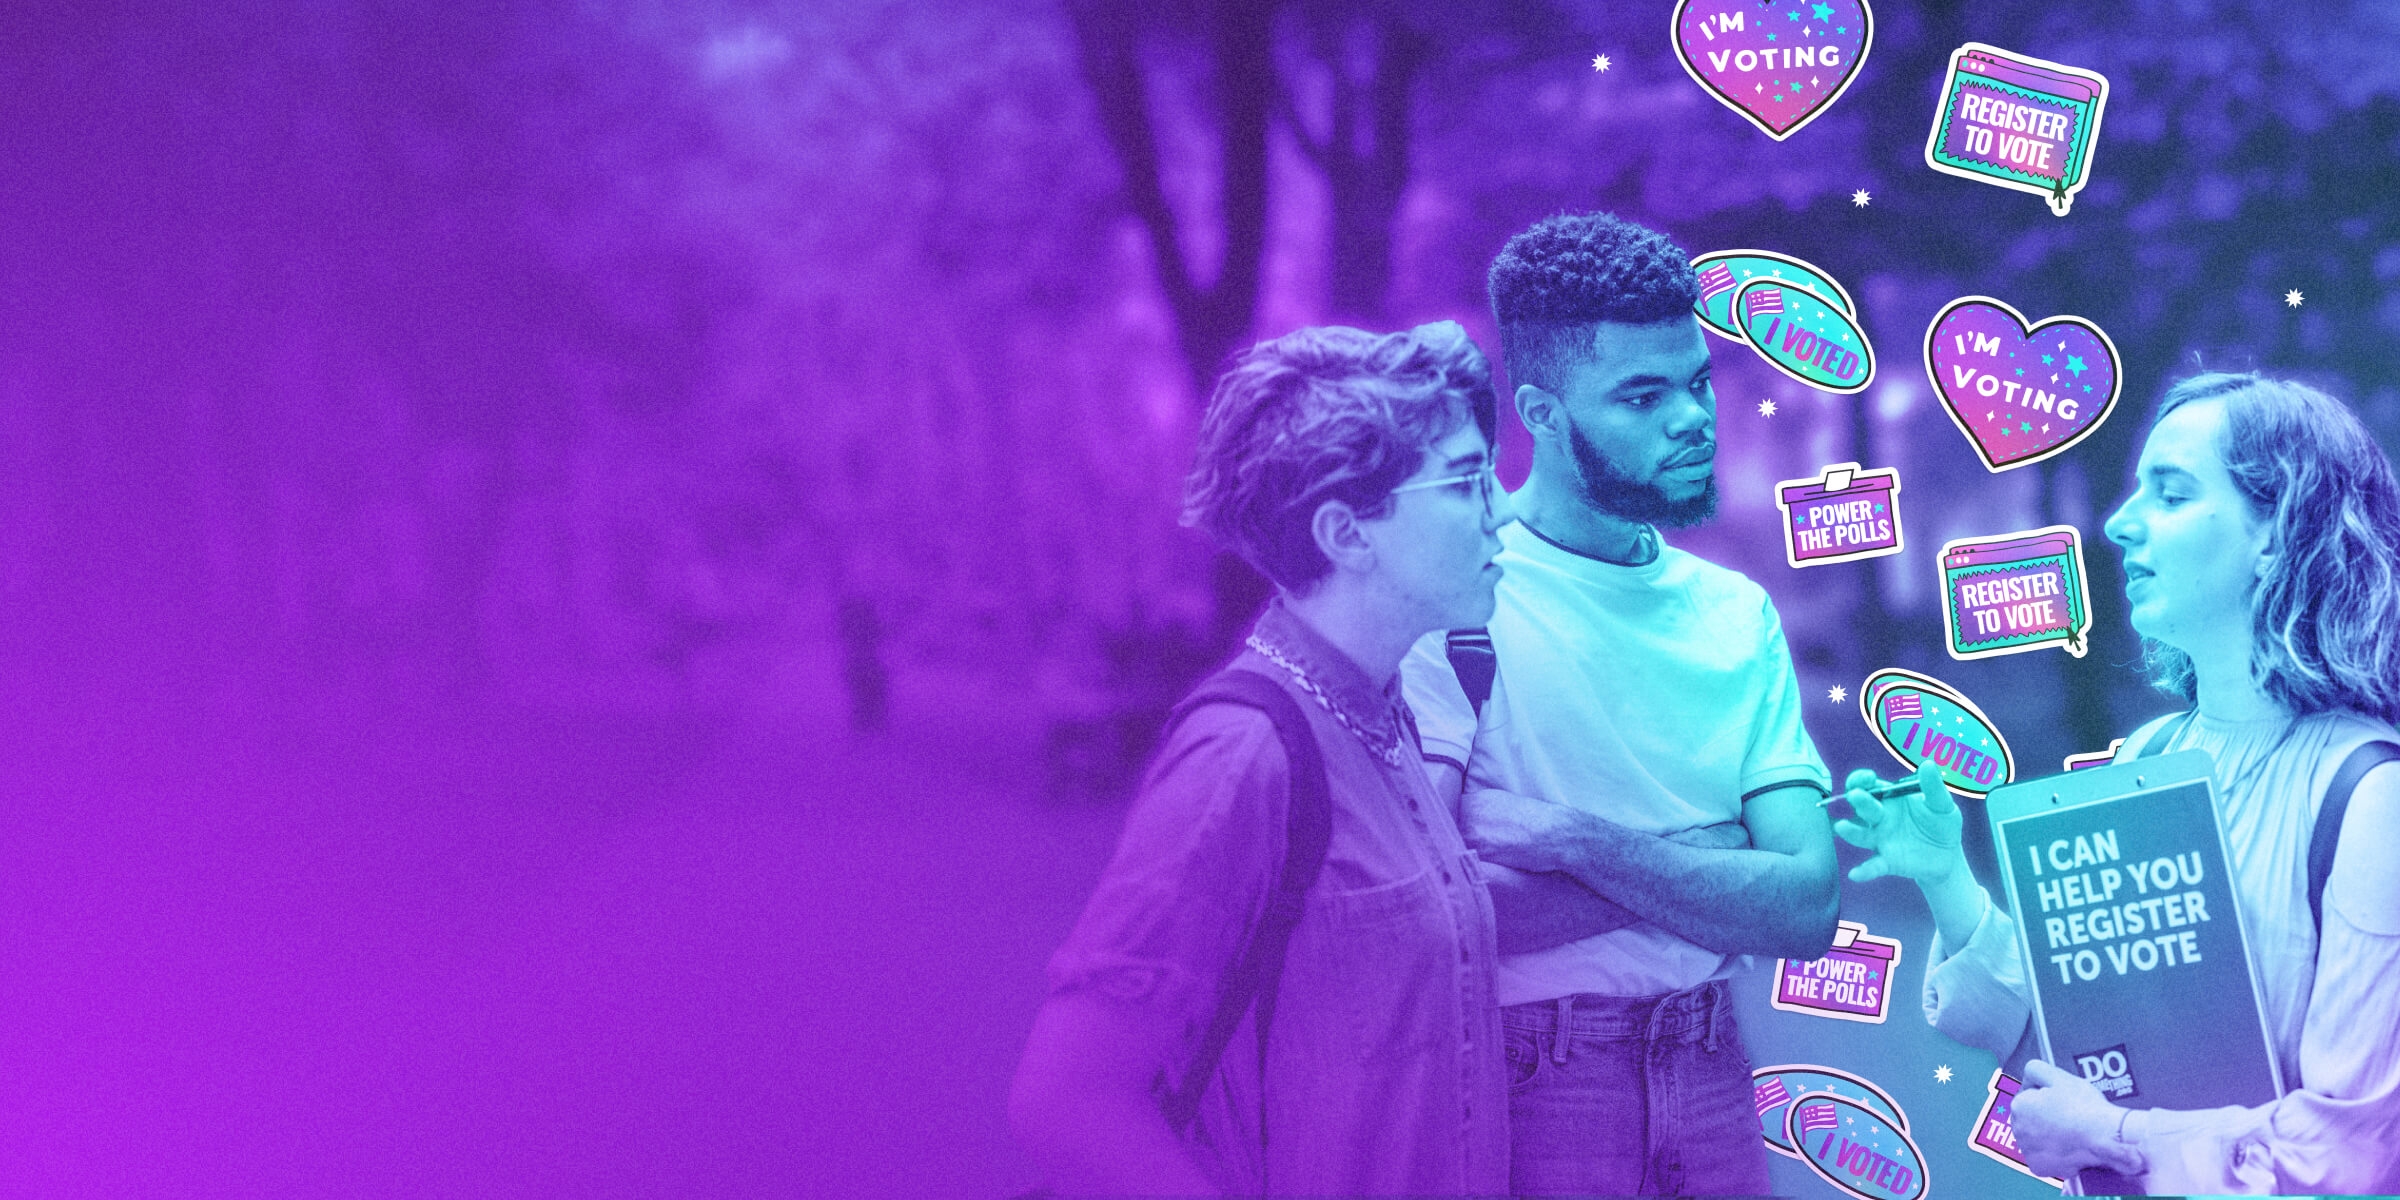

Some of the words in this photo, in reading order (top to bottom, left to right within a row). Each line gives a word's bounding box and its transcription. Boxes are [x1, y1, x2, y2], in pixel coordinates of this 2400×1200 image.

[2028, 845, 2042, 876] I
[2047, 829, 2121, 872] CAN
[2037, 867, 2122, 913] HELP
[2126, 850, 2204, 895] YOU
[2045, 890, 2211, 949] REGISTER
[2050, 949, 2101, 985] TO
[2104, 930, 2202, 976] VOTE
[2077, 1050, 2128, 1082] DO
